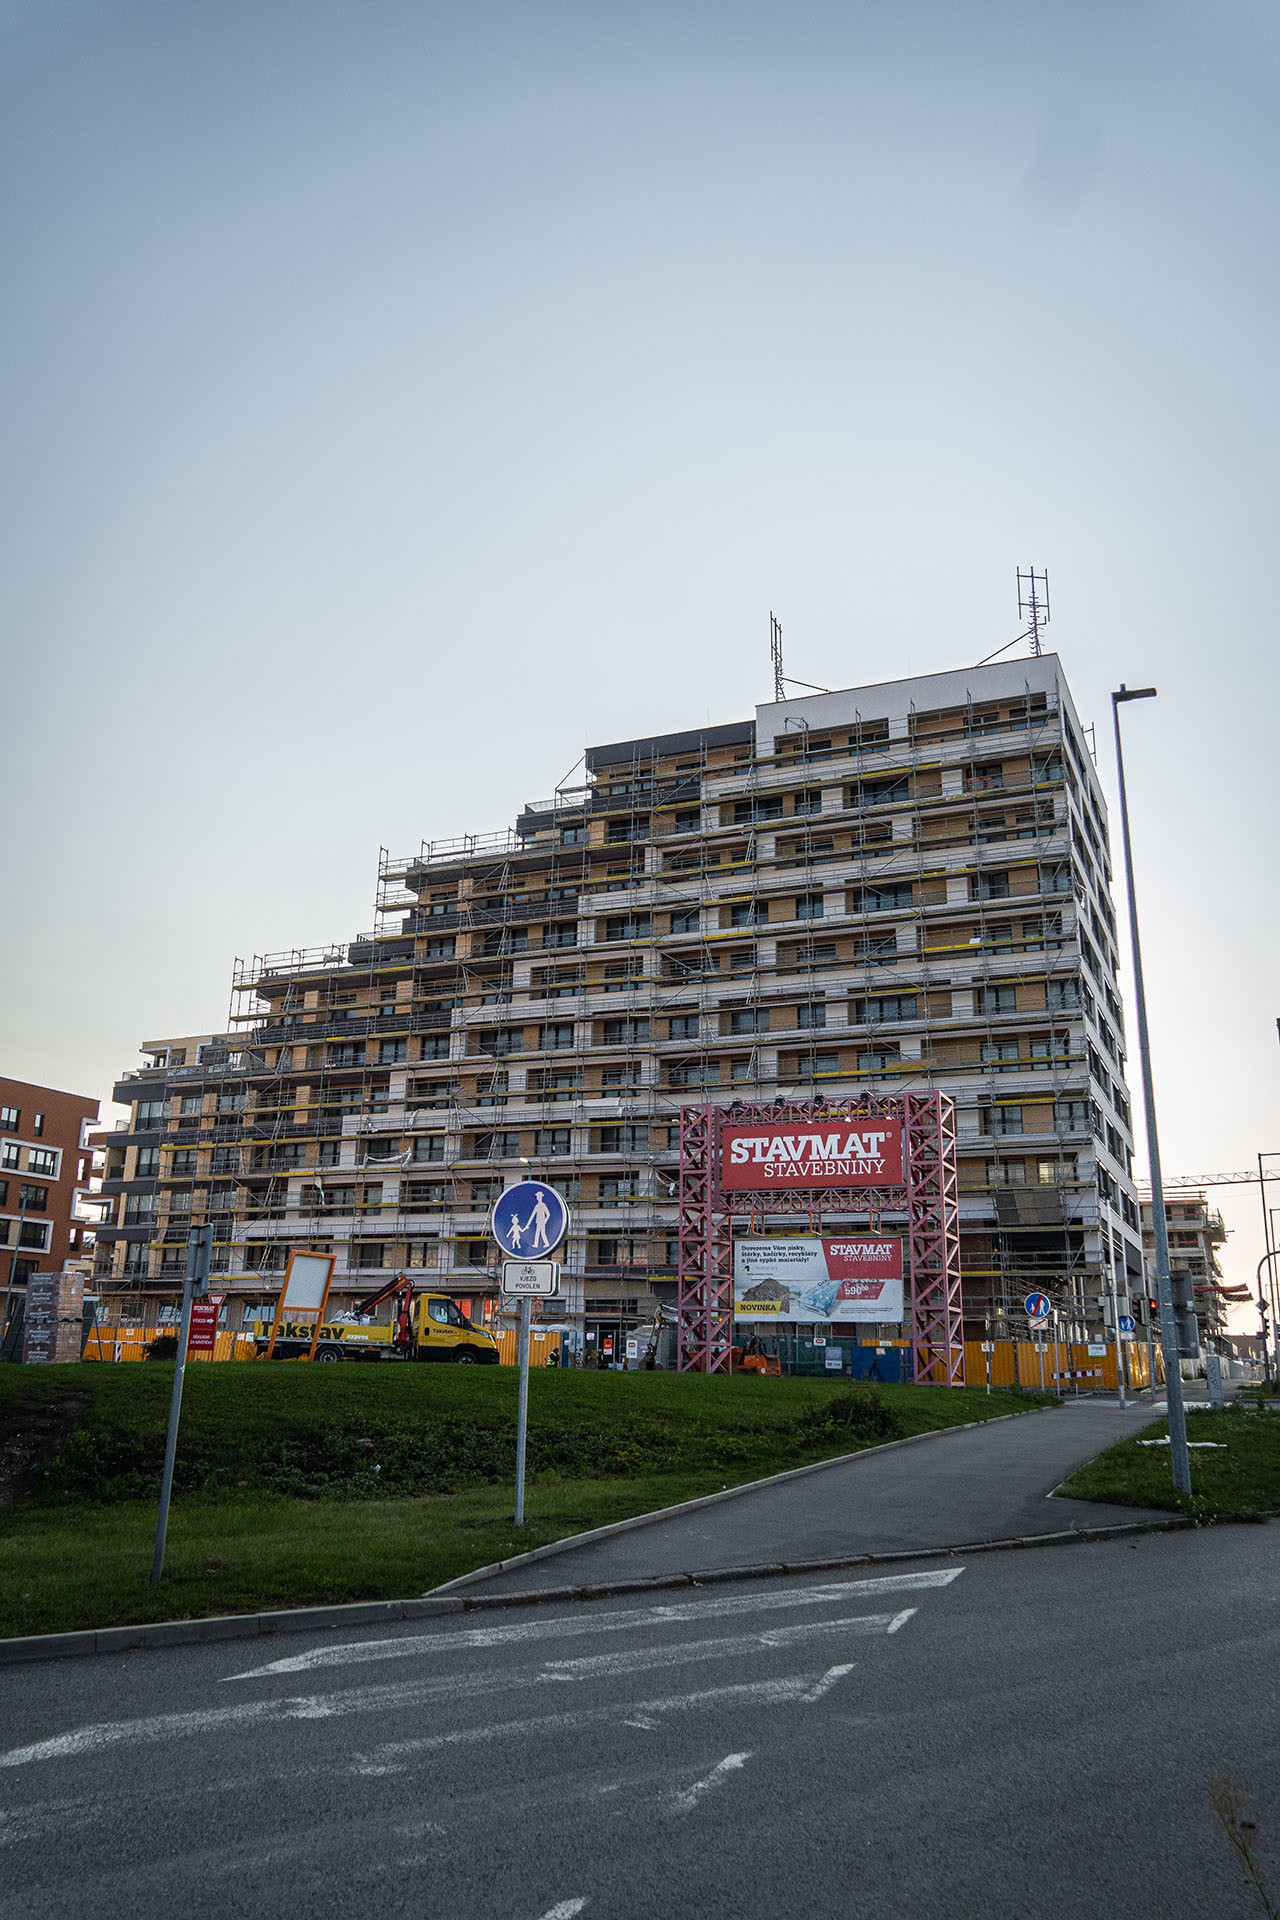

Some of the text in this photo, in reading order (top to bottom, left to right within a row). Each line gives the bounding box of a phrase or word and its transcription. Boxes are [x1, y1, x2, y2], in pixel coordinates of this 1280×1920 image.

[730, 1132, 885, 1164] STAVMAT
[764, 1159, 886, 1178] STAVEBNINY
[830, 1244, 892, 1255] STAVMAT
